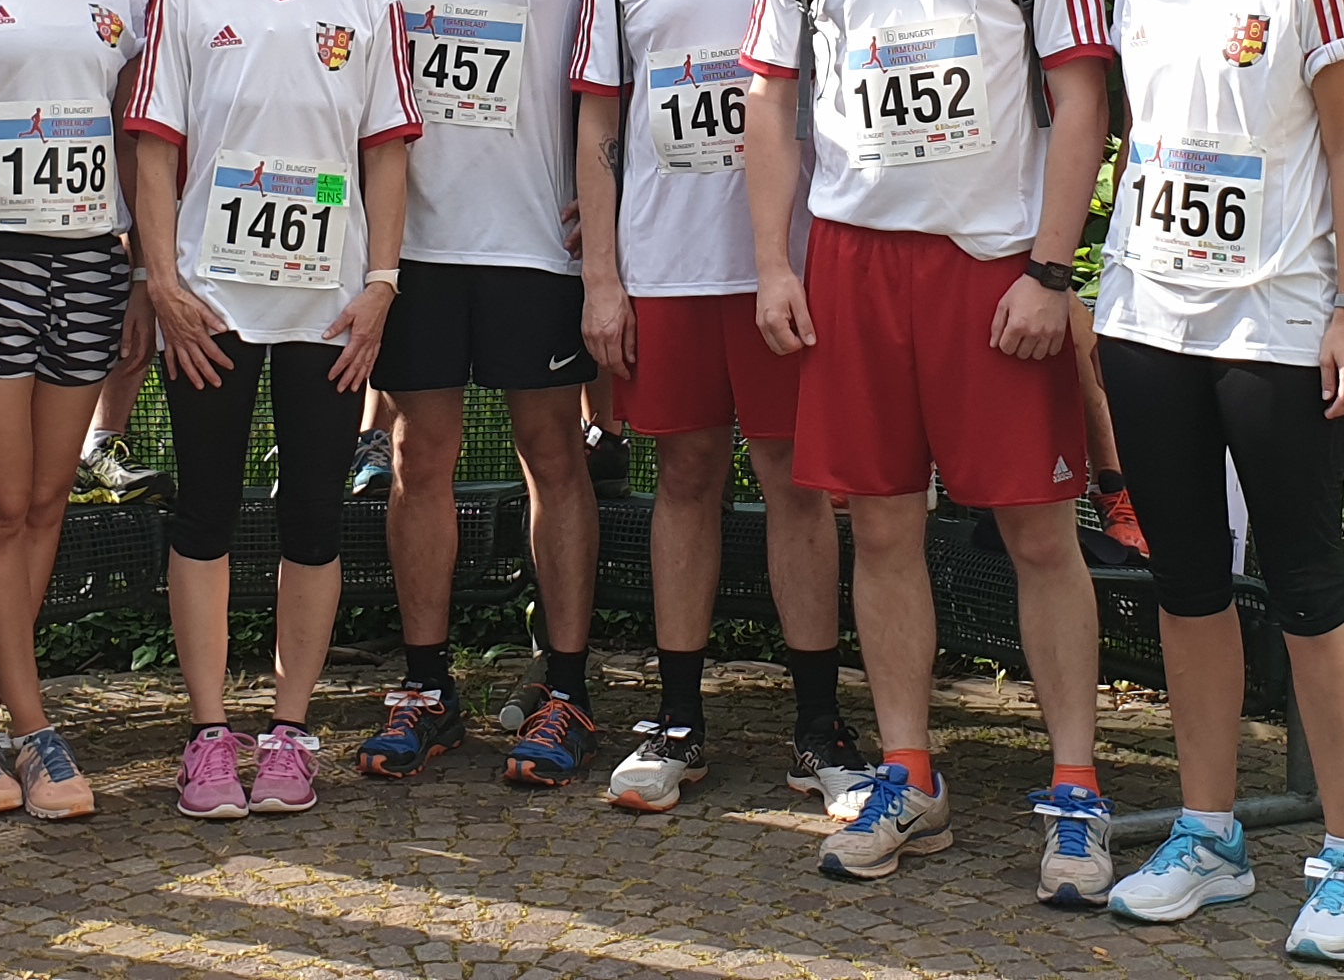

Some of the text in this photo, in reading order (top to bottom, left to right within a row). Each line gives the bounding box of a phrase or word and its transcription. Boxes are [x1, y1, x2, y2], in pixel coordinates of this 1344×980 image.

[898, 28, 934, 41] BUNGERT
[711, 48, 740, 59] BUNGER
[887, 41, 938, 56] FIRMENLAUF
[889, 53, 927, 65] WITTLICH
[854, 66, 975, 129] 1452
[661, 87, 746, 140] 146
[1181, 137, 1220, 149] BUNGERT
[1169, 150, 1220, 163] FIRMENLAUF
[2, 144, 107, 196] 1458
[317, 191, 342, 204] EINS
[1132, 174, 1246, 242] 1456
[220, 196, 331, 253] 1461
